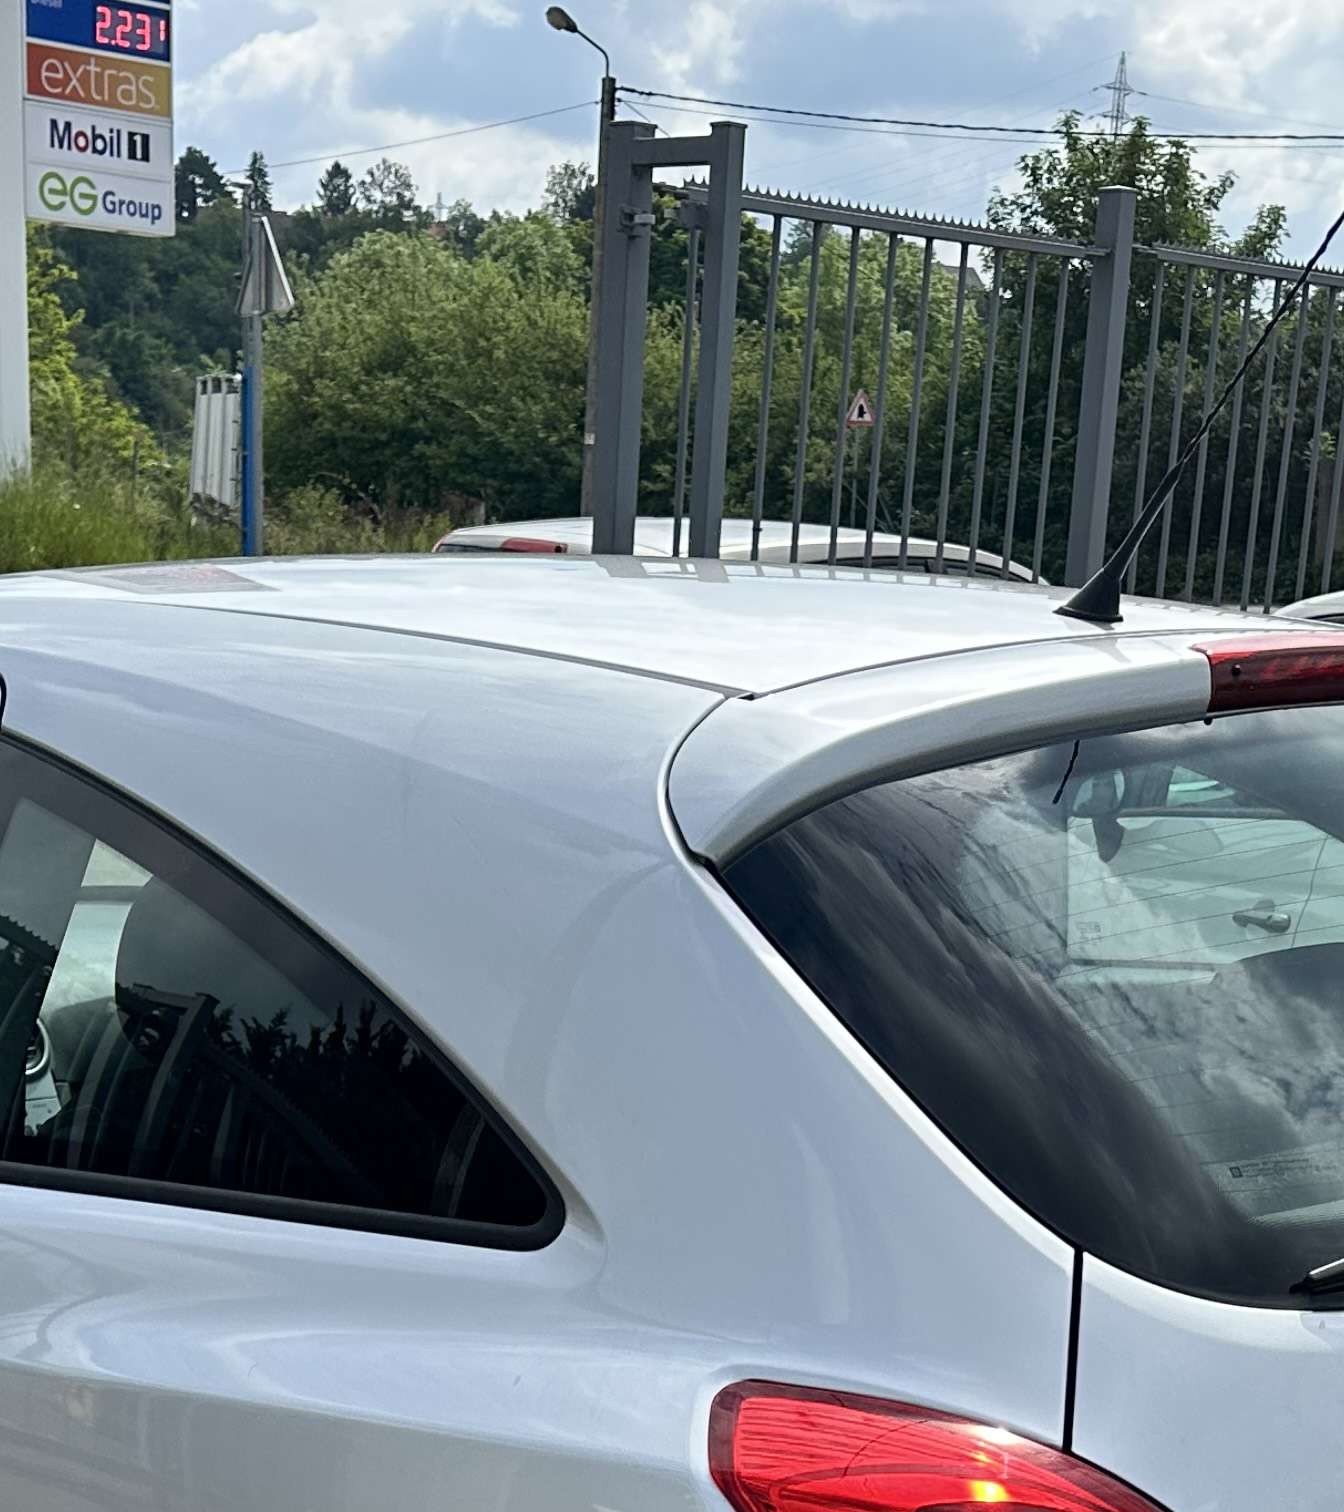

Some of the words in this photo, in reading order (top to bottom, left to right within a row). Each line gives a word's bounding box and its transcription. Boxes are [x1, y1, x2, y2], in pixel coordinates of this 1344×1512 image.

[41, 57, 156, 109] extras
[49, 118, 121, 158] Mobil
[128, 131, 150, 163] 1
[102, 191, 162, 224] Group
